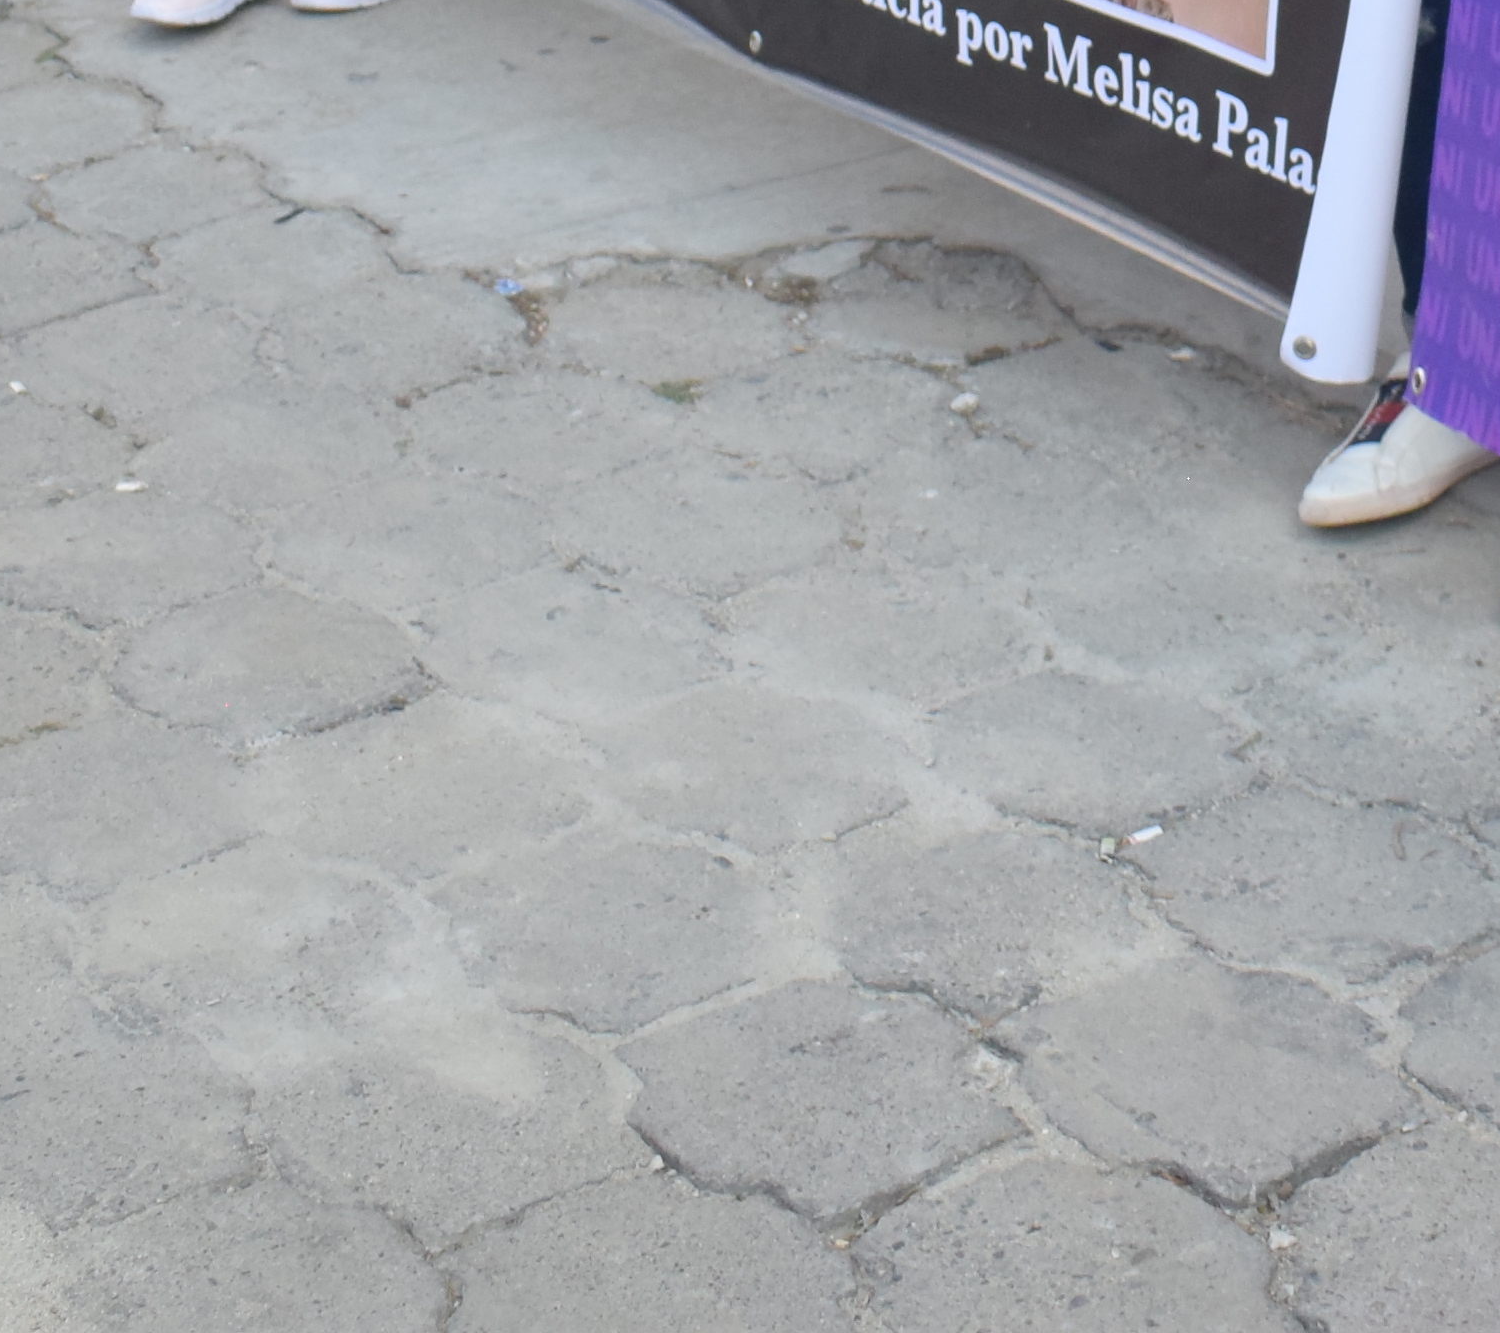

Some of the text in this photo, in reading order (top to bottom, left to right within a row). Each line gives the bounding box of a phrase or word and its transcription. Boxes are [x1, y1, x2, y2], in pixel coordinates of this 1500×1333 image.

[955, 1, 1035, 72] por
[1043, 21, 1204, 143] Melisa
[1214, 89, 1318, 197] Pala
